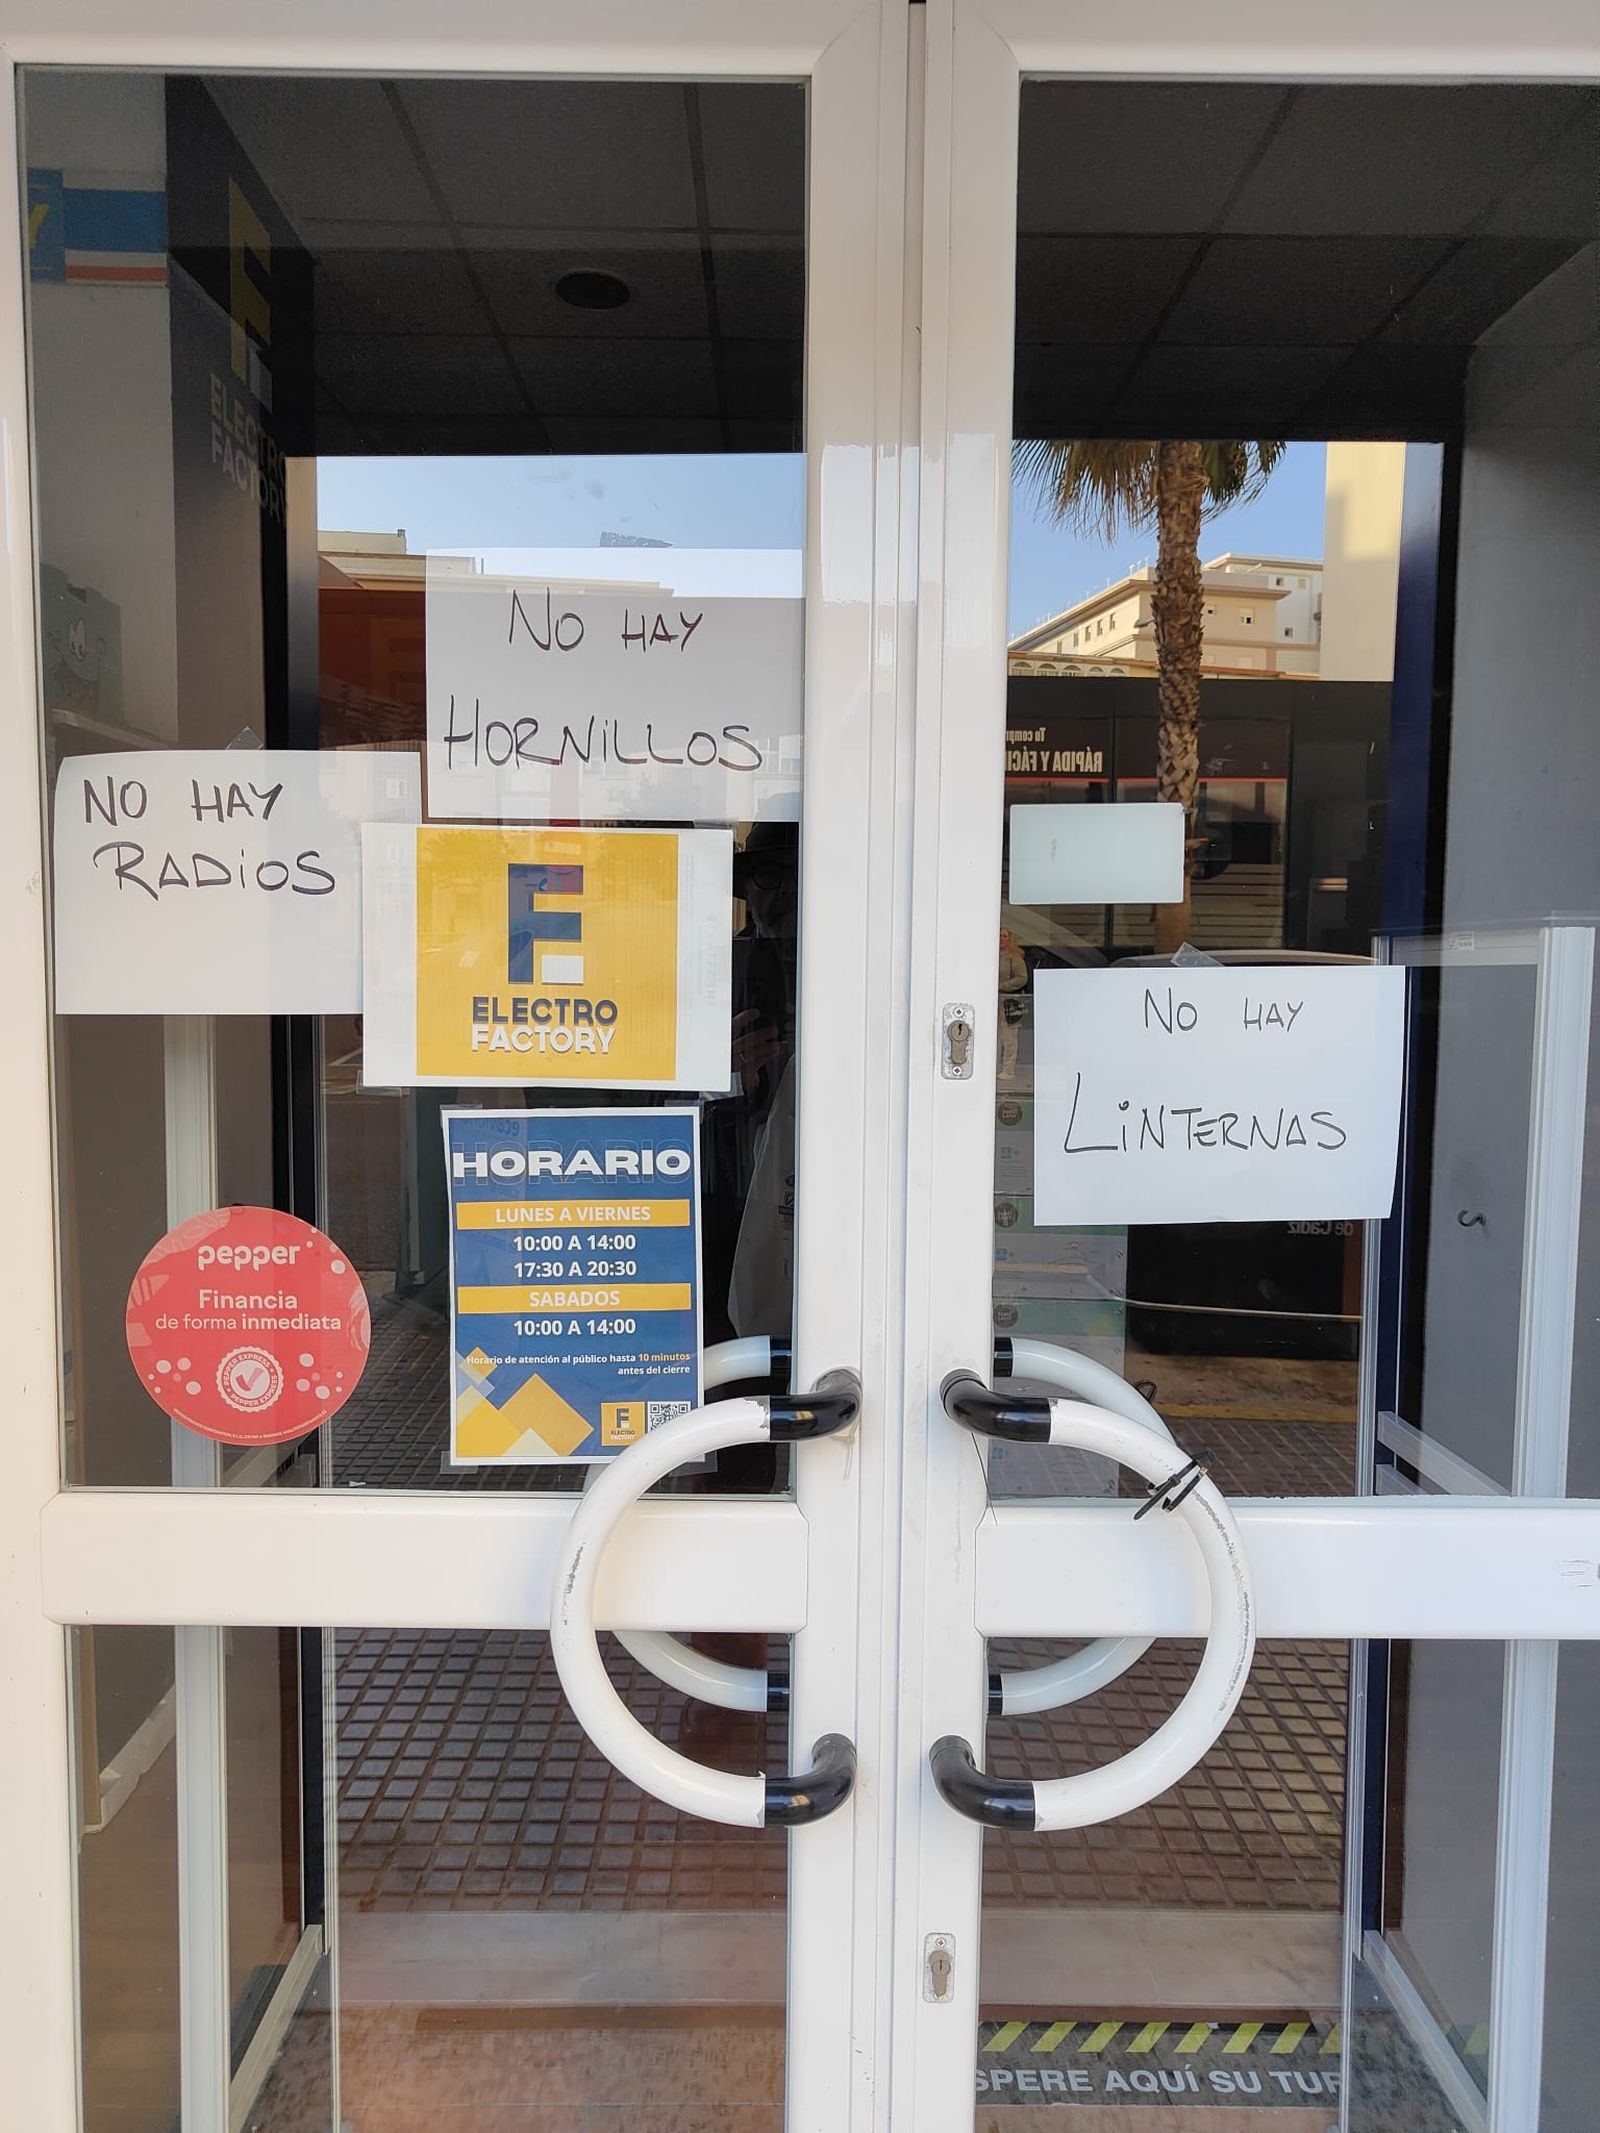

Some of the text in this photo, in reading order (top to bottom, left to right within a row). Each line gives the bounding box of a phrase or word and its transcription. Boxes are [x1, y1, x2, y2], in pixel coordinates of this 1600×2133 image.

[211, 421, 286, 524] FACTOR
[621, 608, 703, 652] HAY
[83, 776, 283, 826] NO HAY
[472, 997, 618, 1026] ELECTRO
[1243, 997, 1303, 1031] HAY
[471, 1026, 616, 1053] FACTORY
[453, 1150, 691, 1177] HORARIO
[495, 1206, 651, 1223] LUNES A VIERNES
[513, 1234, 636, 1251] 10:00 A 14:00
[198, 1245, 301, 1271] pepper
[514, 1261, 636, 1278] 17:30 A 20:30
[199, 1288, 298, 1309] Financia
[529, 1291, 620, 1307] SABADOS
[155, 1313, 342, 1330] de forma inmediata
[513, 1319, 636, 1336] 10:00 A 14:00
[466, 1351, 690, 1366] Horario de atención al público hasta 10 minutos
[617, 1365, 690, 1375] antes del cierre
[1105, 2063, 1200, 2093] AQUÍ
[1211, 2069, 1262, 2093] SU
